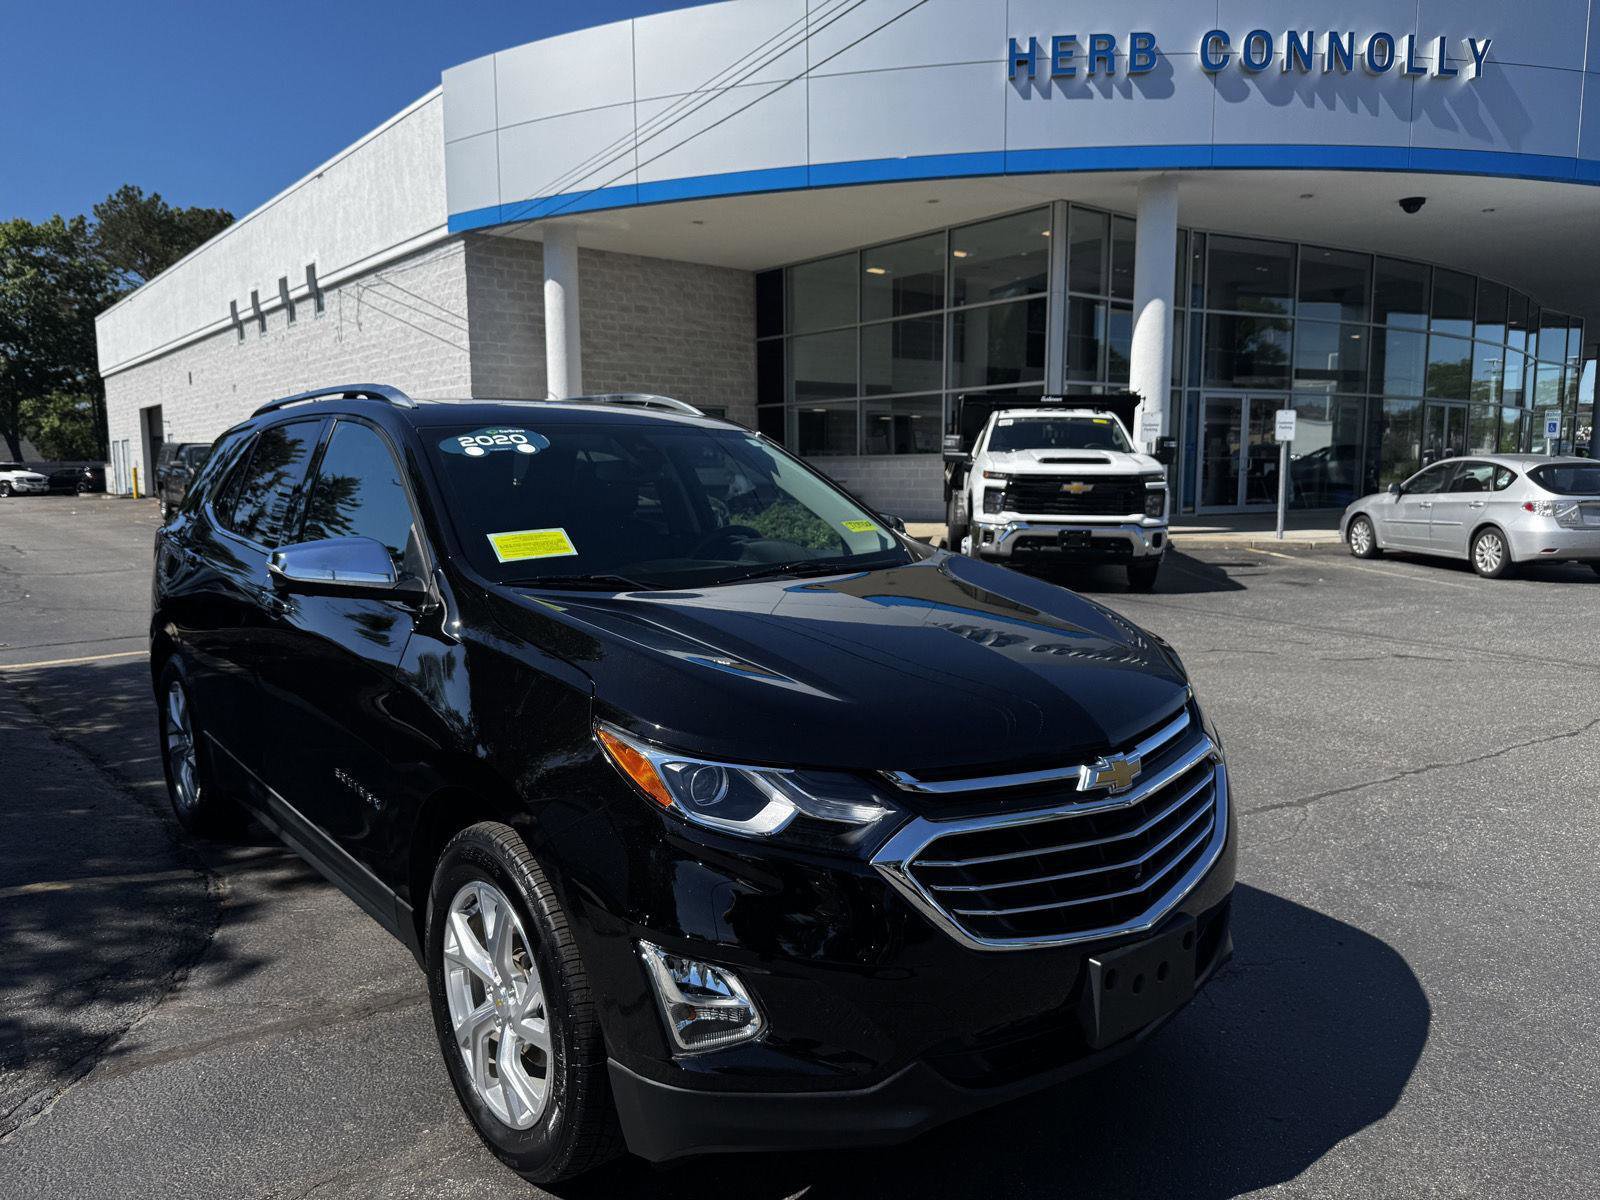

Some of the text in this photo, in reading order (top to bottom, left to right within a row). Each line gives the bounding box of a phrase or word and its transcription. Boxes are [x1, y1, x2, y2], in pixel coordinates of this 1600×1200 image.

[1008, 29, 1492, 80] HERB CONNOLLY
[458, 434, 528, 447] 2020
